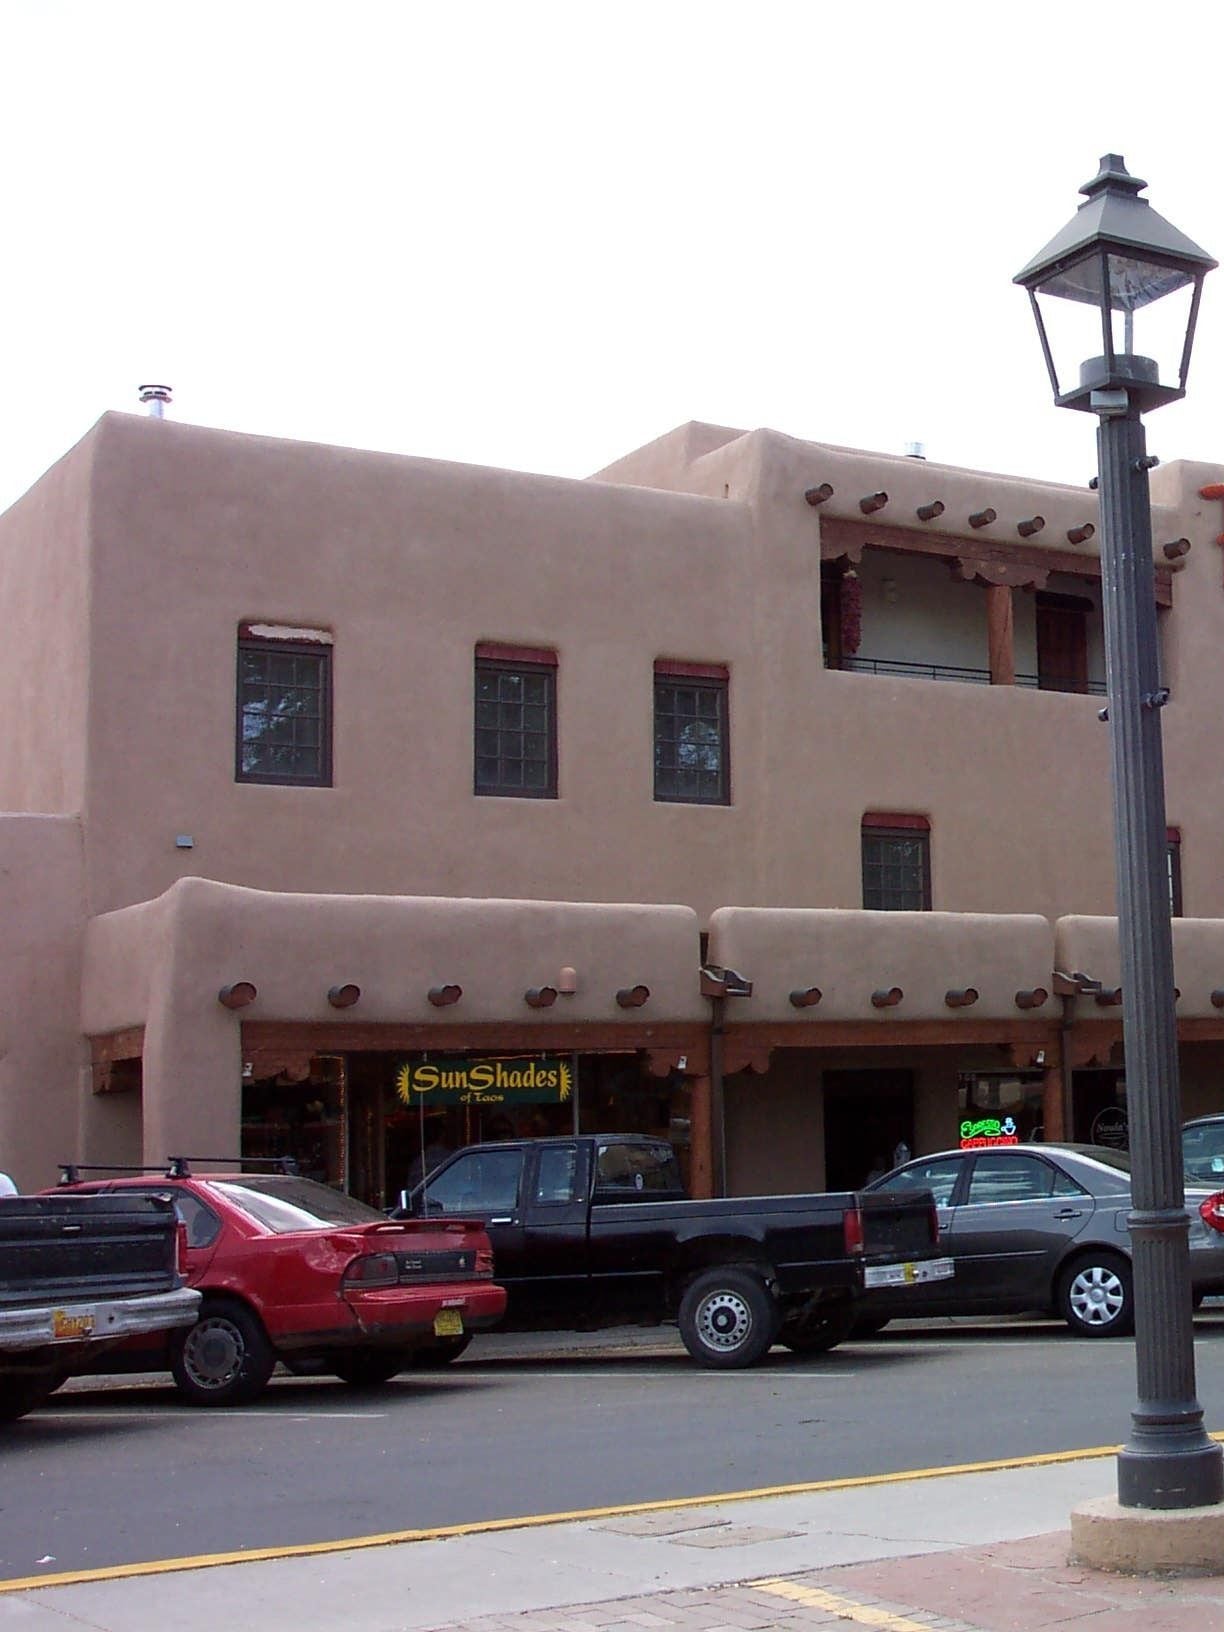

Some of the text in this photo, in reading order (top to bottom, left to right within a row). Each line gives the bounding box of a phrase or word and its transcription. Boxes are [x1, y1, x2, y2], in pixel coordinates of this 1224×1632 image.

[412, 1062, 558, 1092] SunShades
[460, 1092, 504, 1103] of Taos
